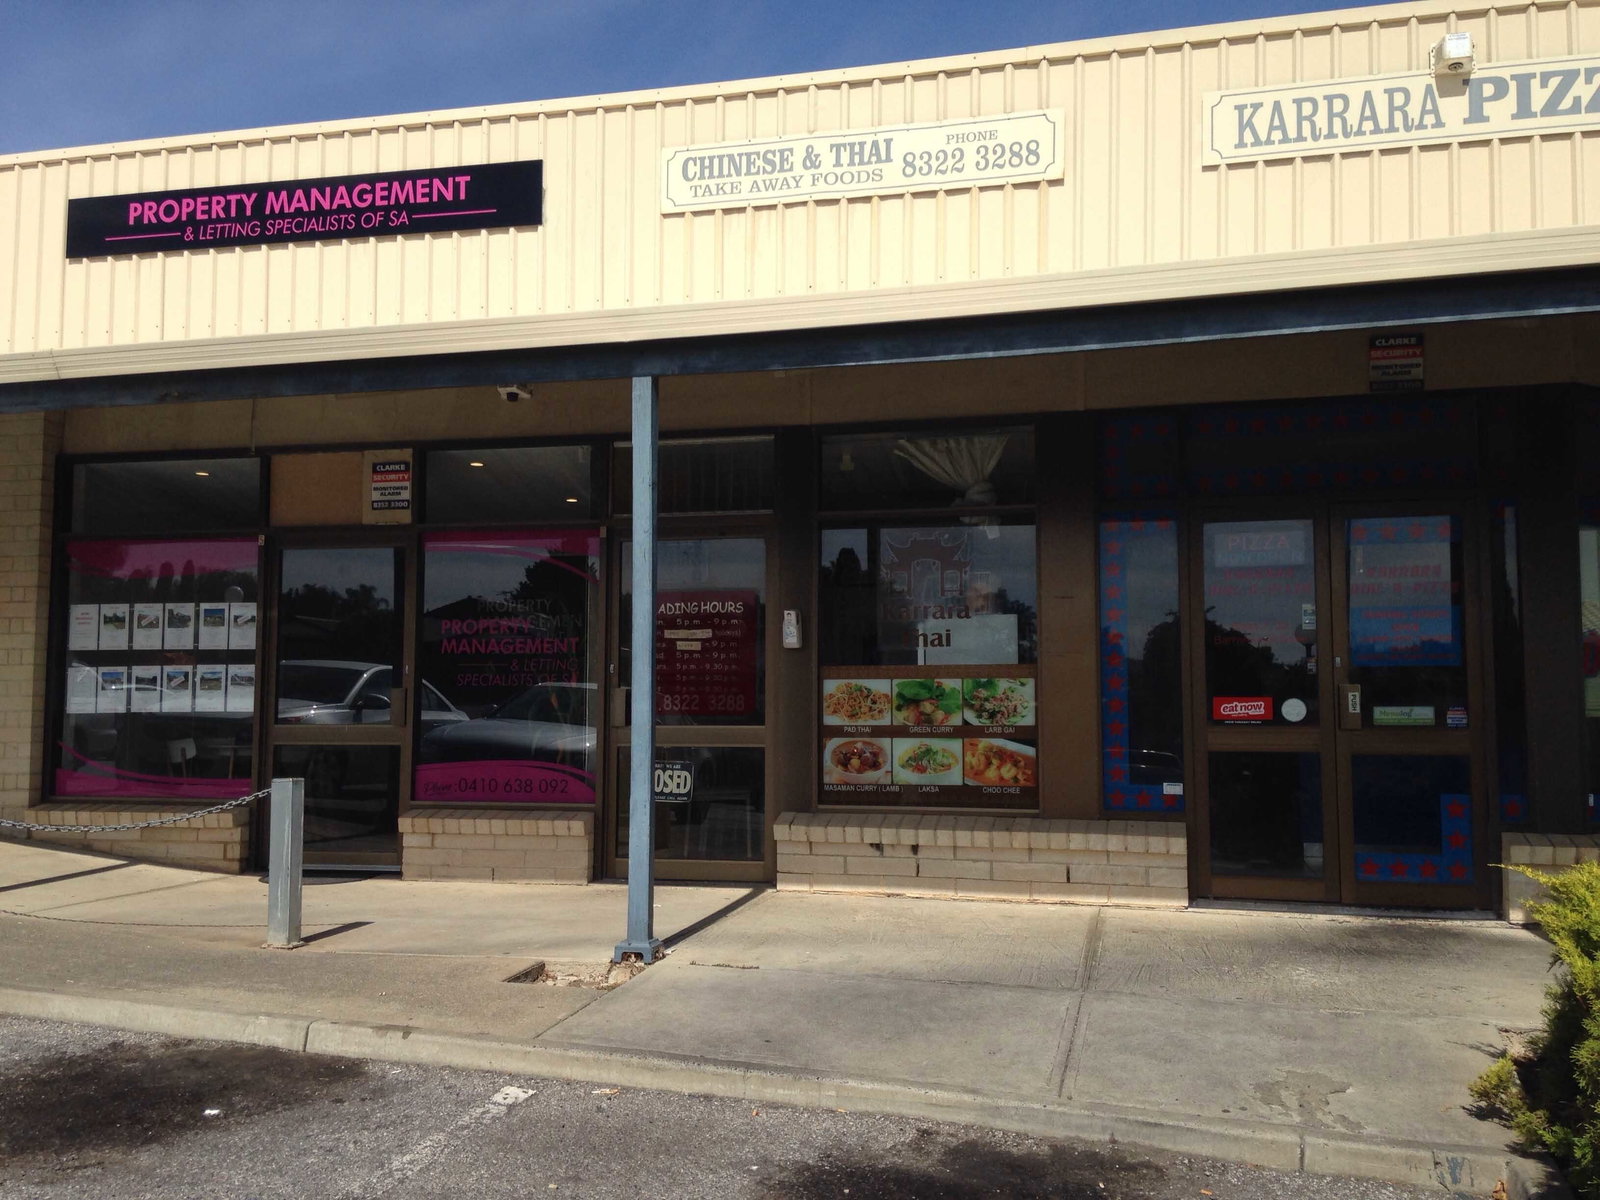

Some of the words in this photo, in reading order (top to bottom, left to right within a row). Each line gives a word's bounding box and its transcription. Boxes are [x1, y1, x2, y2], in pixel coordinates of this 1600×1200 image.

[1234, 83, 1446, 149] KARRARA
[945, 129, 999, 145] PHONE
[682, 145, 795, 182] CHINESE
[802, 145, 822, 171] &
[829, 137, 893, 168] THAI
[901, 147, 966, 178] 8322
[975, 139, 1041, 172] 3288
[689, 181, 742, 198] TAKE
[748, 174, 804, 193] AWAY
[810, 168, 884, 187] FOODS
[128, 192, 258, 226] PROPERTY
[265, 176, 472, 217] MANAGEMENT
[183, 226, 195, 241] &
[199, 220, 260, 240] LETTING
[264, 214, 356, 237] SPECIALISTS
[360, 212, 384, 229] OF
[388, 210, 410, 227] SA
[373, 473, 409, 481] SECURITY
[657, 602, 699, 615] ADING
[701, 601, 744, 614] HOURS
[440, 618, 530, 635] PROPERTY
[441, 636, 580, 655] MANAGEMENT
[510, 659, 520, 672] &
[523, 657, 579, 673] LETTING
[456, 673, 534, 687] SPECIALISTS
[663, 694, 699, 710] 8322
[708, 694, 744, 711] 3288
[1222, 703, 1238, 713] eat
[1240, 703, 1263, 711] now
[458, 777, 498, 793] 0410
[504, 778, 533, 793] 638
[538, 779, 569, 794] 092
[654, 769, 692, 793] OSED
[982, 786, 1002, 794] CHOO
